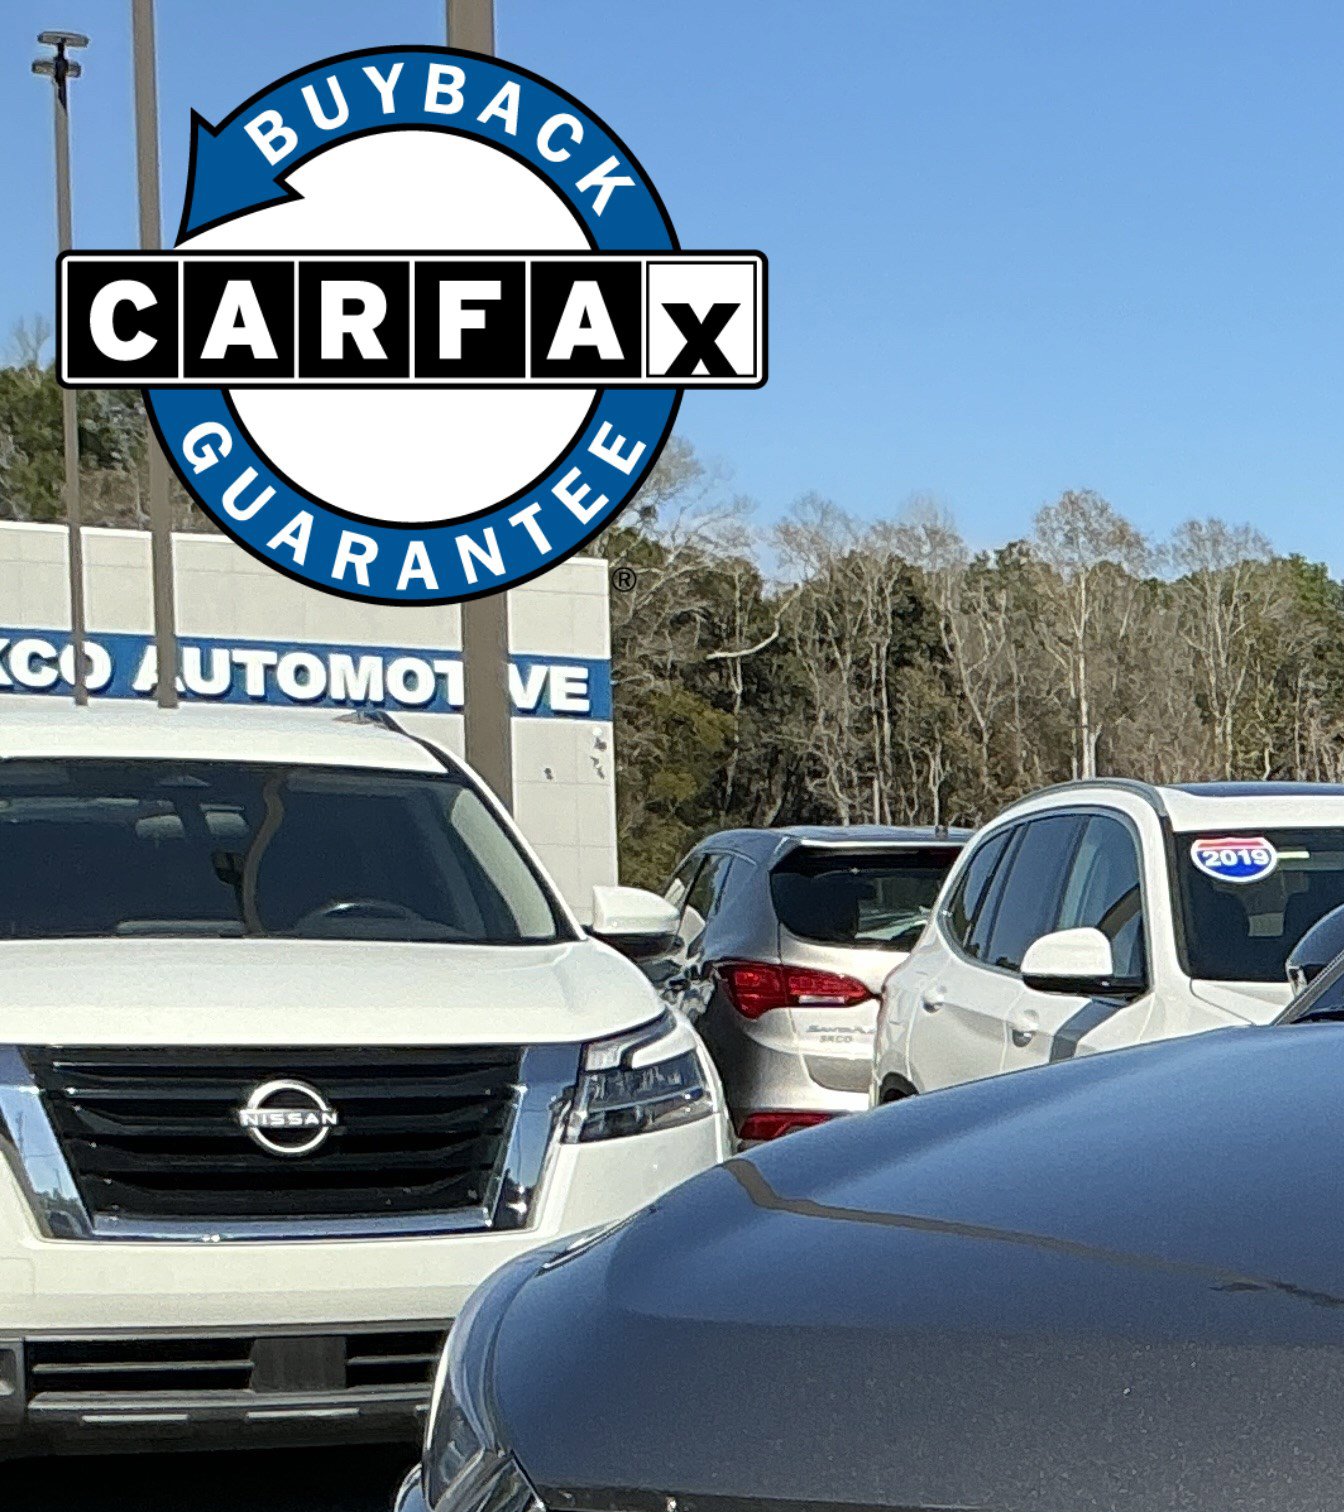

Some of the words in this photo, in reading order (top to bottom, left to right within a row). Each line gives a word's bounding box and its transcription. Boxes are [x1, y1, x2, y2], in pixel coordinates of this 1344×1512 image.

[132, 644, 590, 712] AUTOMOTVE
[1202, 849, 1269, 866] 2019
[241, 1111, 338, 1126] NISSAN
